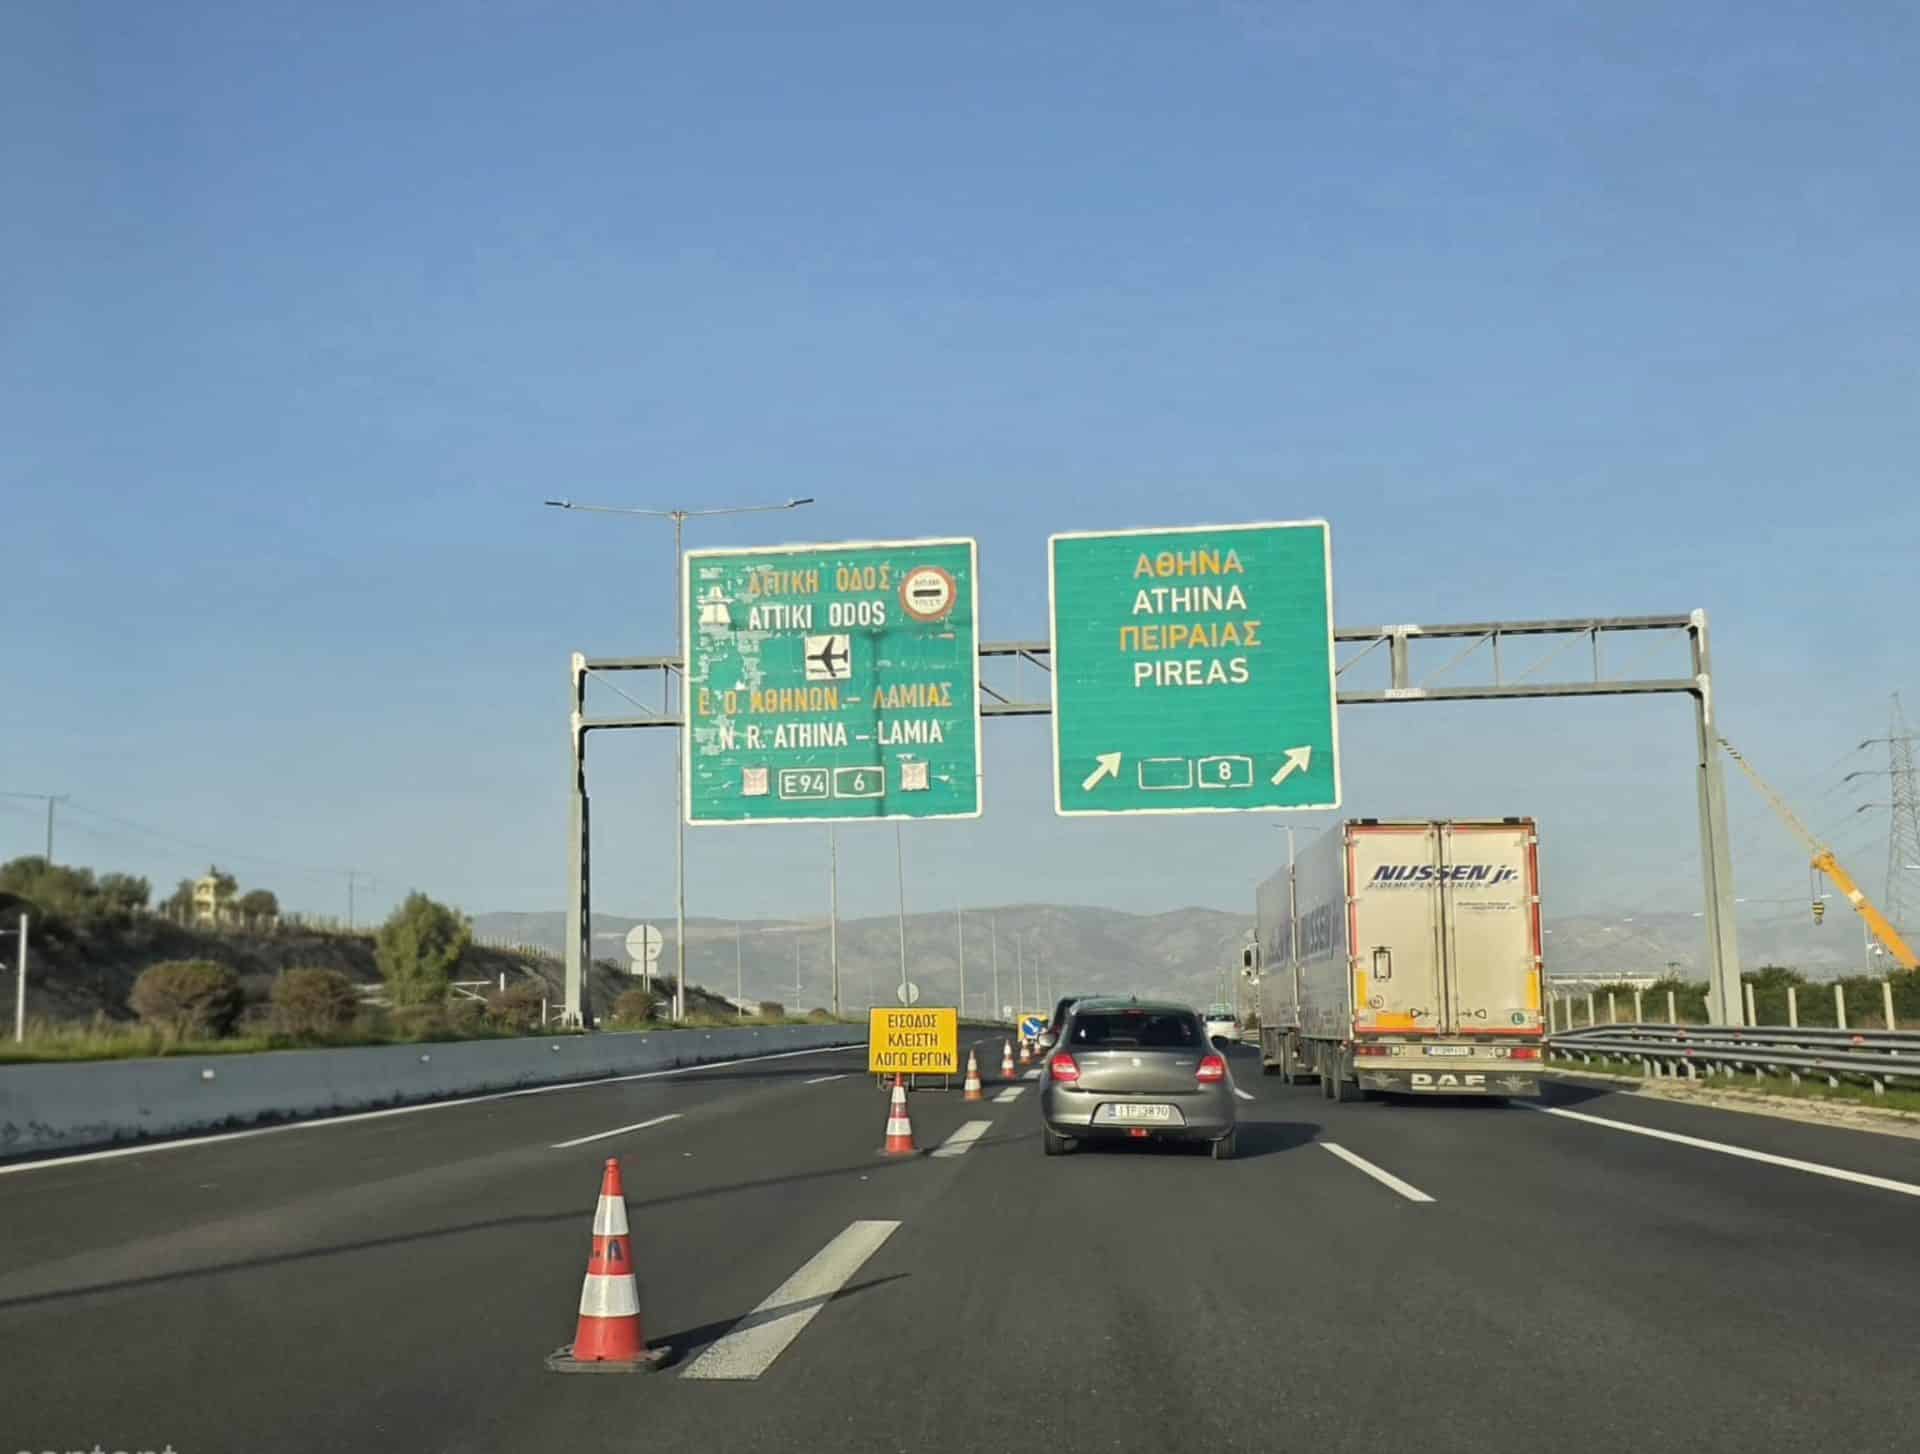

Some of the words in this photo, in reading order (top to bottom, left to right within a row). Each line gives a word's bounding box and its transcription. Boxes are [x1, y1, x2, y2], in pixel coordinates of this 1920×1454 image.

[1133, 549, 1244, 579] ΑΘΗΝΑ
[836, 566, 891, 593] ΟΔΟΣ
[1132, 585, 1247, 615] ATHINA
[750, 603, 812, 630] ATTIKI
[829, 600, 886, 627] ODOS
[1119, 620, 1262, 652] ΠΕΙΡΑΙΑΣ
[1134, 657, 1250, 687] PIREAS
[751, 686, 839, 714] ΑΘΗΝΩΝ
[872, 682, 953, 709] ΛΑΜΙΑΣ
[774, 722, 848, 749] ATHINA
[877, 718, 943, 745] LAMIA
[853, 774, 865, 791] 6
[1218, 761, 1232, 780] 8
[1374, 864, 1492, 881] NIJSSEN
[888, 1014, 938, 1028] ΕΙΣΟΔΟΣ
[888, 1033, 938, 1047] ΚΛΕΙΣΤΗ
[876, 1051, 908, 1066] ΛΟΓΩ
[912, 1051, 952, 1066] ΕΡΓΩΝ
[1411, 1073, 1486, 1087] DAF
